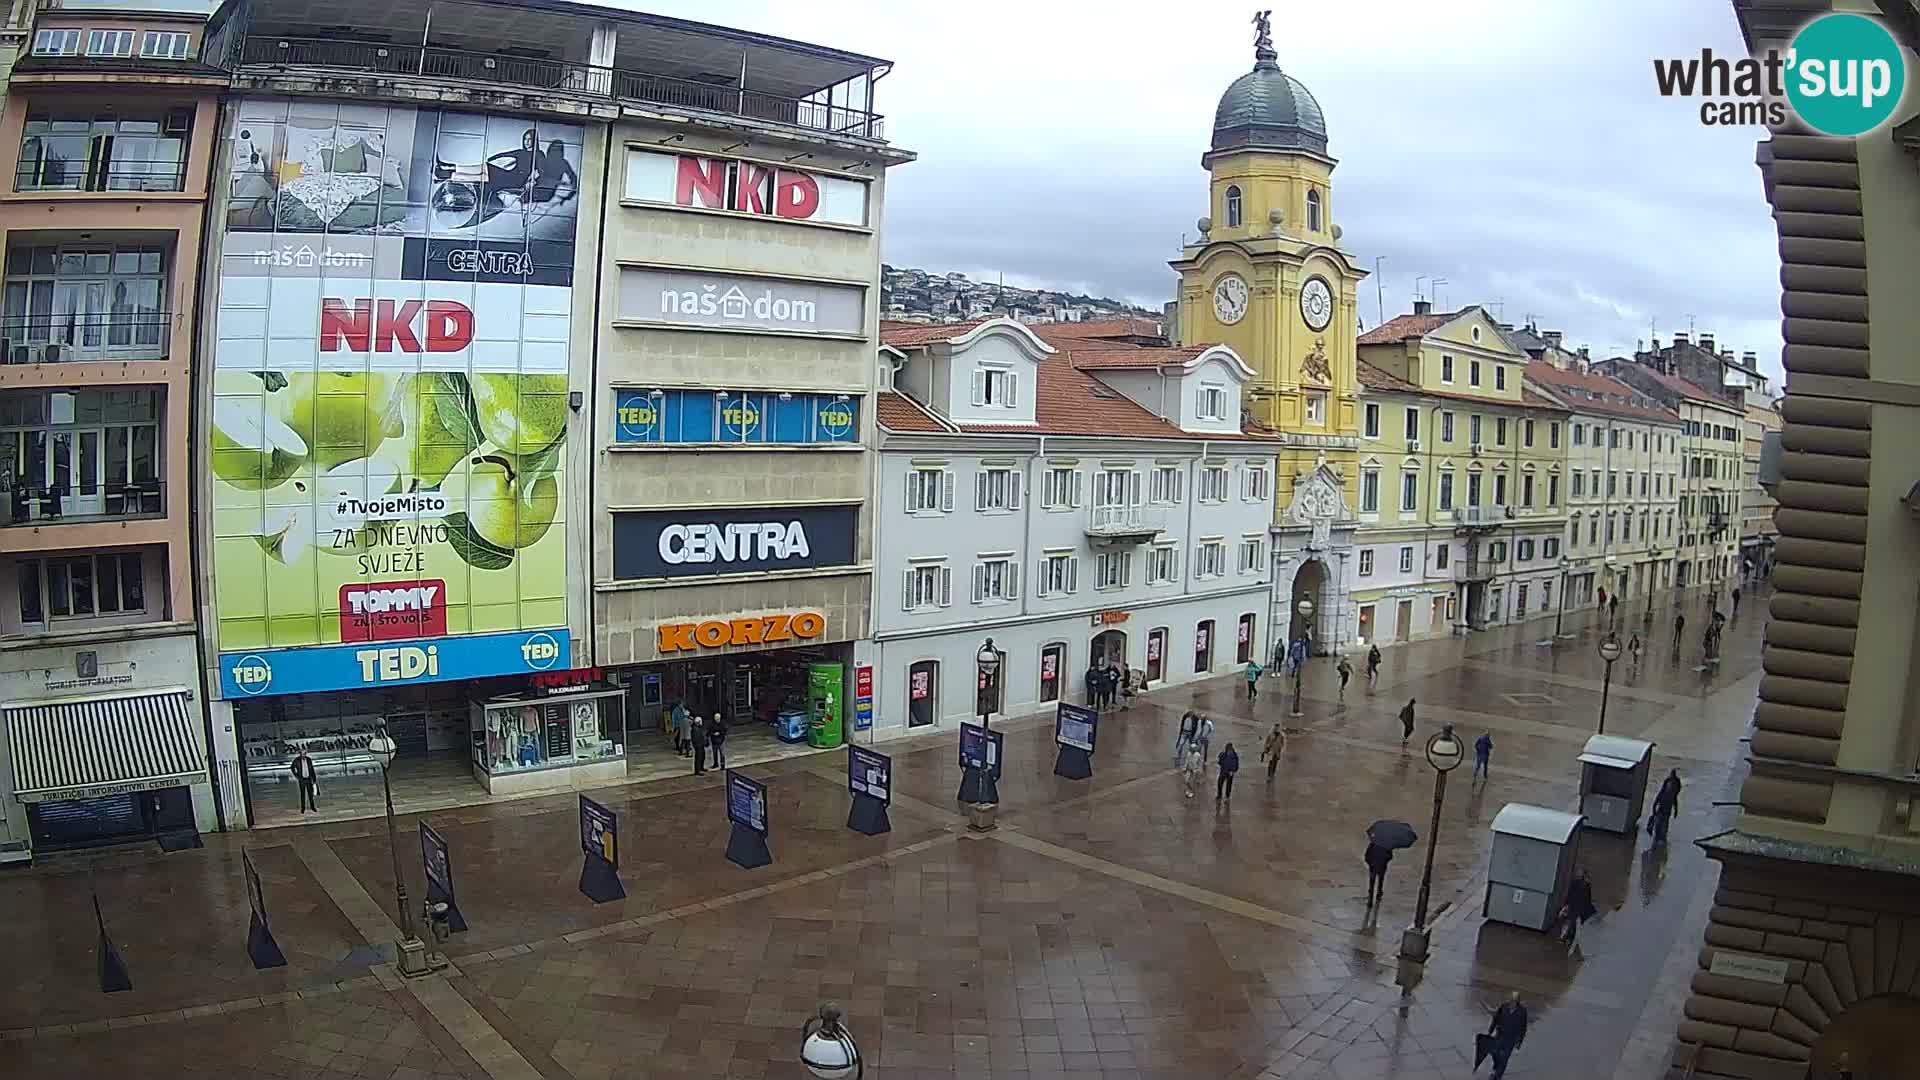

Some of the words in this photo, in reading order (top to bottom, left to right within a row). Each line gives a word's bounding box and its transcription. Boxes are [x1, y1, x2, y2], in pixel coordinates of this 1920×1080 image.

[676, 155, 820, 219] NKD
[254, 245, 293, 267] naš
[318, 246, 365, 267] dom
[447, 248, 534, 275] CENTRA
[660, 284, 717, 315] naš
[752, 290, 816, 323] dom
[319, 297, 476, 353] NKD
[617, 407, 657, 425] TEDi
[722, 408, 760, 426] TEDi
[819, 410, 853, 427] TEDi
[337, 496, 445, 516] #TvojeMisto
[332, 528, 356, 549] ZA
[365, 523, 449, 548] DNEVNO
[658, 520, 810, 565] CENTRA
[358, 547, 425, 575] SVJEŽE
[347, 586, 438, 614] TOMMY
[658, 612, 825, 653] KORZO
[356, 645, 439, 683] TEDi
[521, 642, 559, 661] TEDi
[232, 665, 272, 684] TEDi
